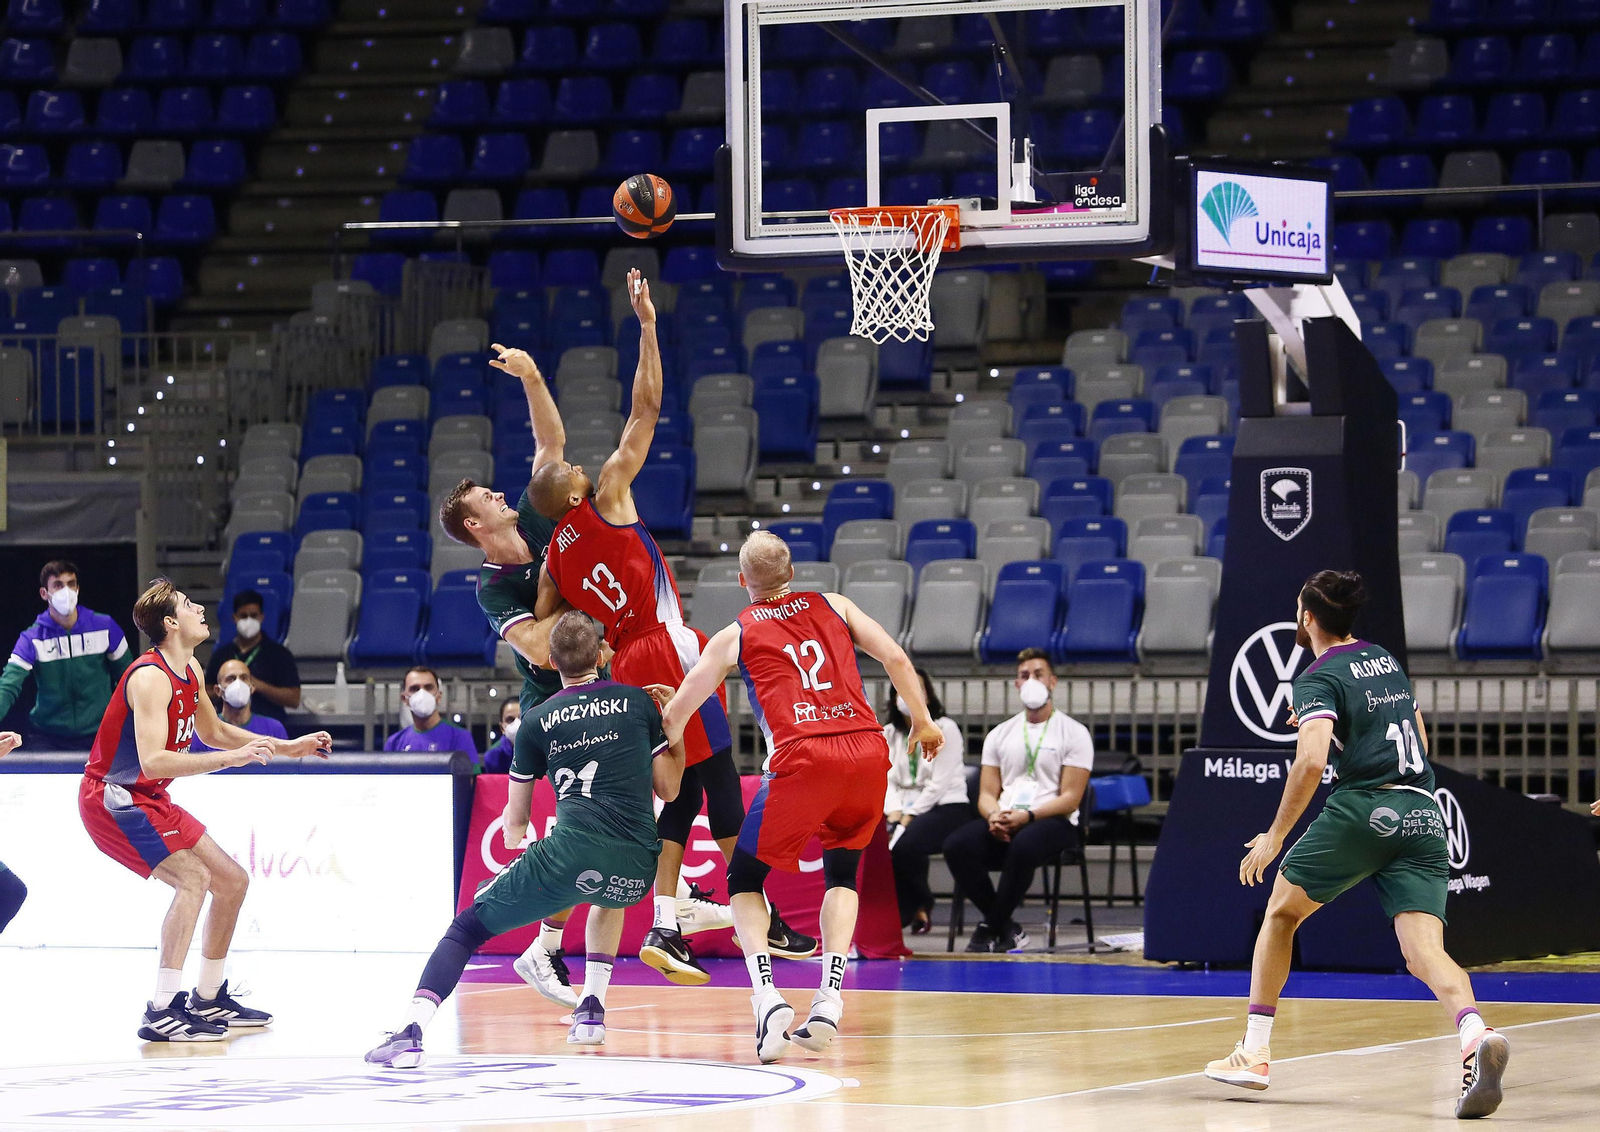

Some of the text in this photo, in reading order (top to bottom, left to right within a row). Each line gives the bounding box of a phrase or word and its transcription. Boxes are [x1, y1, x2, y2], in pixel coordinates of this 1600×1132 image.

[1075, 184, 1096, 197] liga
[1075, 195, 1120, 207] endesa
[1256, 219, 1321, 255] Unicaja
[582, 562, 628, 613] 13
[782, 639, 833, 691] 12
[1350, 655, 1399, 680] ALONSO
[540, 698, 628, 733] WACZYŃSKI
[1385, 719, 1425, 775] 10
[554, 760, 599, 801] 21
[1204, 757, 1281, 784] Málaga
[1402, 827, 1445, 839] MÁLAGA
[1403, 819, 1425, 828] DEL
[606, 885, 643, 897] DEL SOL
[609, 875, 646, 889] COSTA
